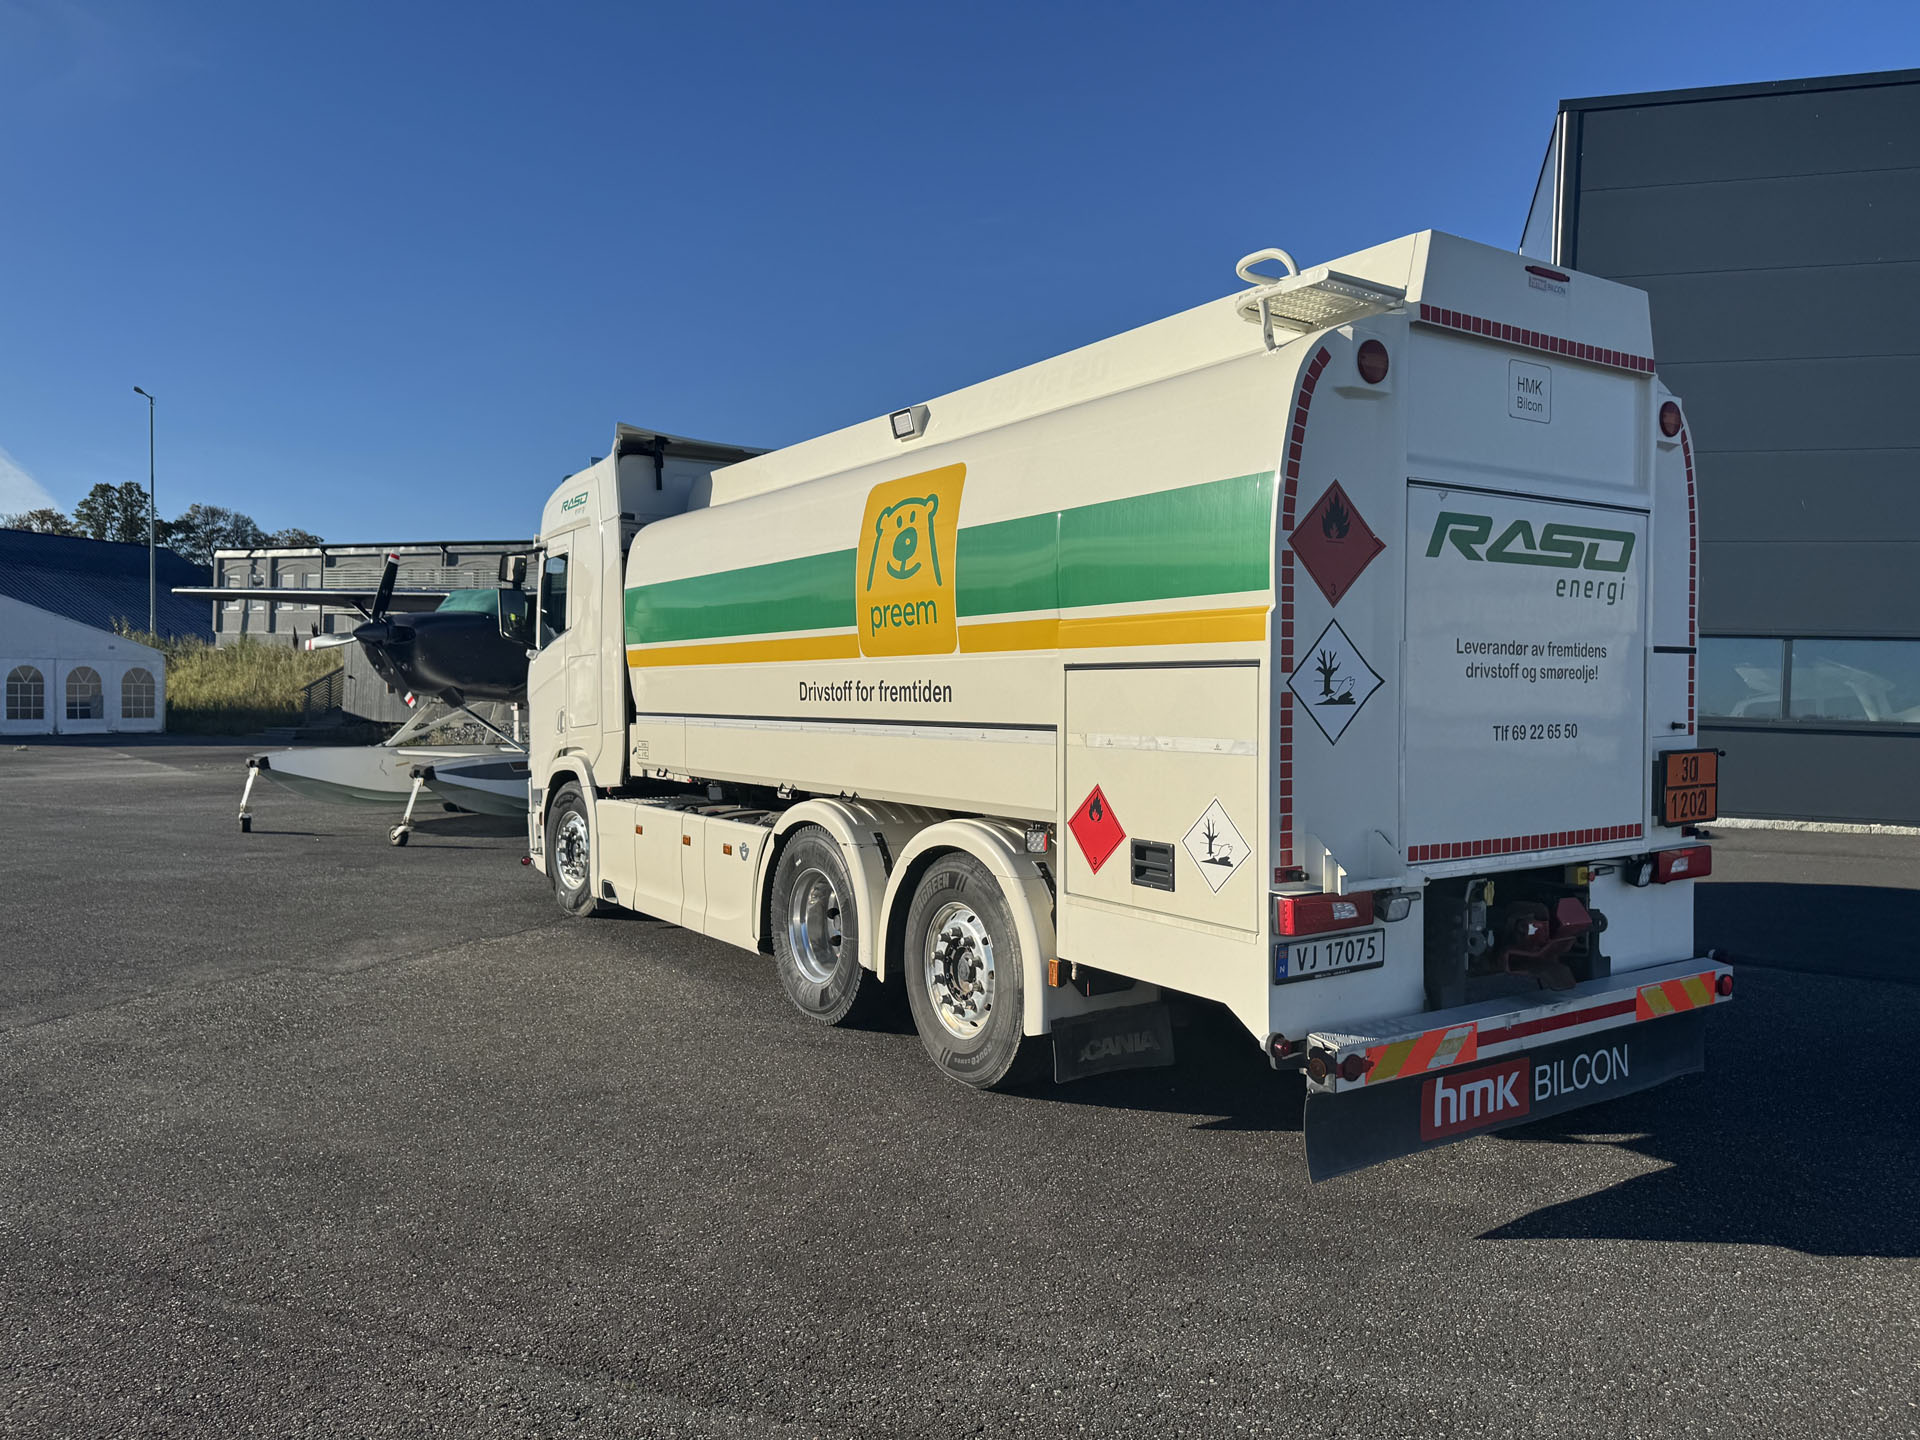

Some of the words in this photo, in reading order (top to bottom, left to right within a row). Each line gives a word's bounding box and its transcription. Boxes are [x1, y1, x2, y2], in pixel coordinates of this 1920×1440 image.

[1517, 376, 1543, 396] HMK
[1517, 396, 1543, 412] Bilcon
[1331, 583, 1337, 596] 3
[1556, 577, 1626, 605] energi
[870, 599, 938, 637] preem
[1456, 638, 1528, 656] Leverandør
[1531, 644, 1546, 657] av
[1548, 641, 1607, 658] fremtidens
[1466, 662, 1519, 679] drivstoff
[1521, 668, 1536, 682] og
[1539, 663, 1600, 683] smøreolje!
[799, 680, 853, 703] Drivstoff
[855, 681, 875, 702] for
[878, 680, 953, 704] fremtiden
[1493, 725, 1509, 741] Tlf
[1512, 725, 1526, 741] 69
[1530, 725, 1544, 741] 22
[1547, 724, 1561, 740] 65
[1564, 724, 1578, 739] 50
[1681, 756, 1699, 783] 30
[1672, 789, 1707, 819] 1202
[1092, 856, 1098, 865] 3
[1296, 945, 1318, 971] VJ
[1326, 936, 1376, 966] 17075
[1280, 965, 1285, 973] N
[1433, 1070, 1521, 1127] hmk
[1534, 1043, 1629, 1102] BILCON
